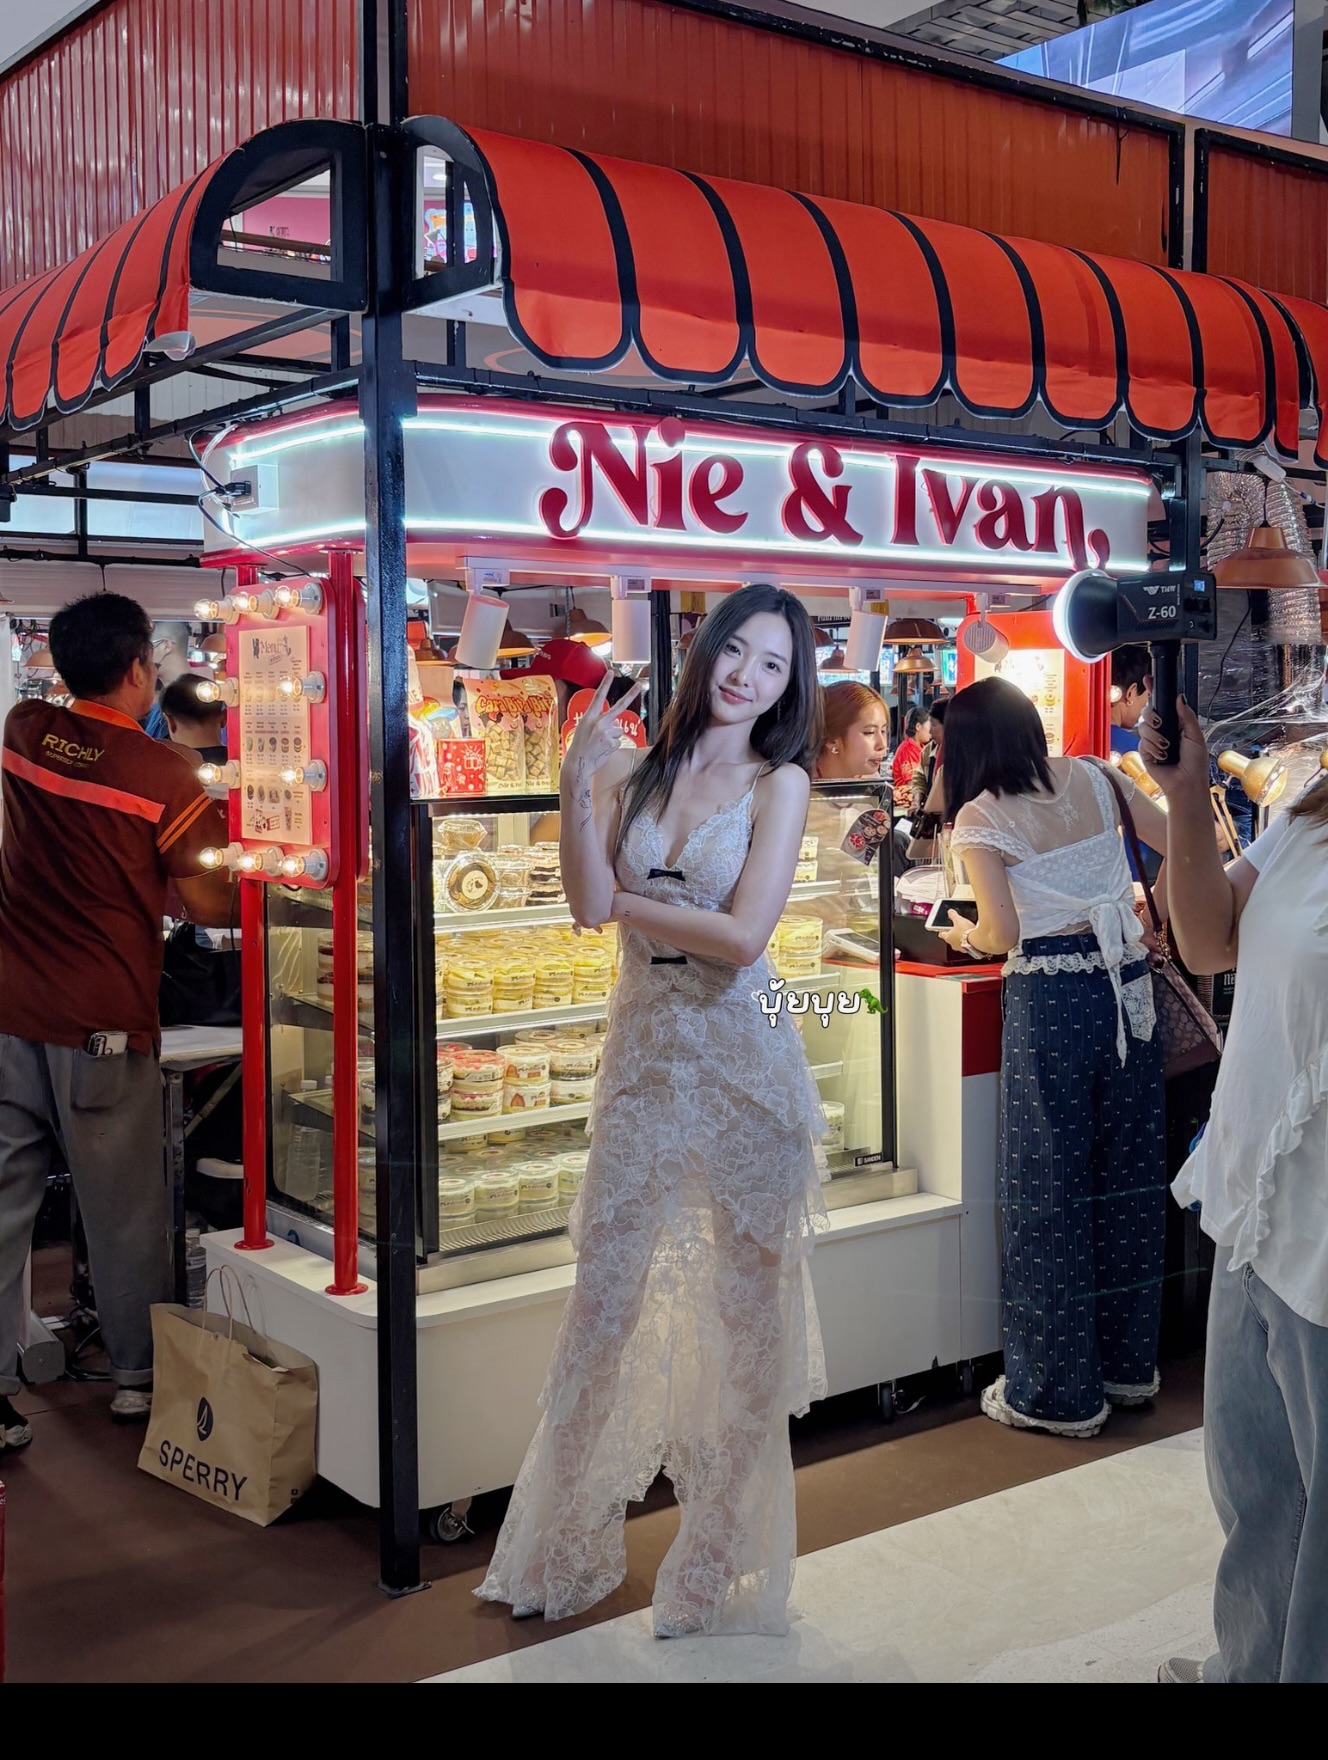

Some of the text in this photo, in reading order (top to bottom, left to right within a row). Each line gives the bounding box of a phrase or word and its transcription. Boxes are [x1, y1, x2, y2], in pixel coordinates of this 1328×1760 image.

[538, 416, 1111, 572] Nie & Ivan
[1147, 605, 1177, 620] Z-60
[42, 733, 105, 761] RICHLY
[159, 1439, 248, 1501] SPERRY
